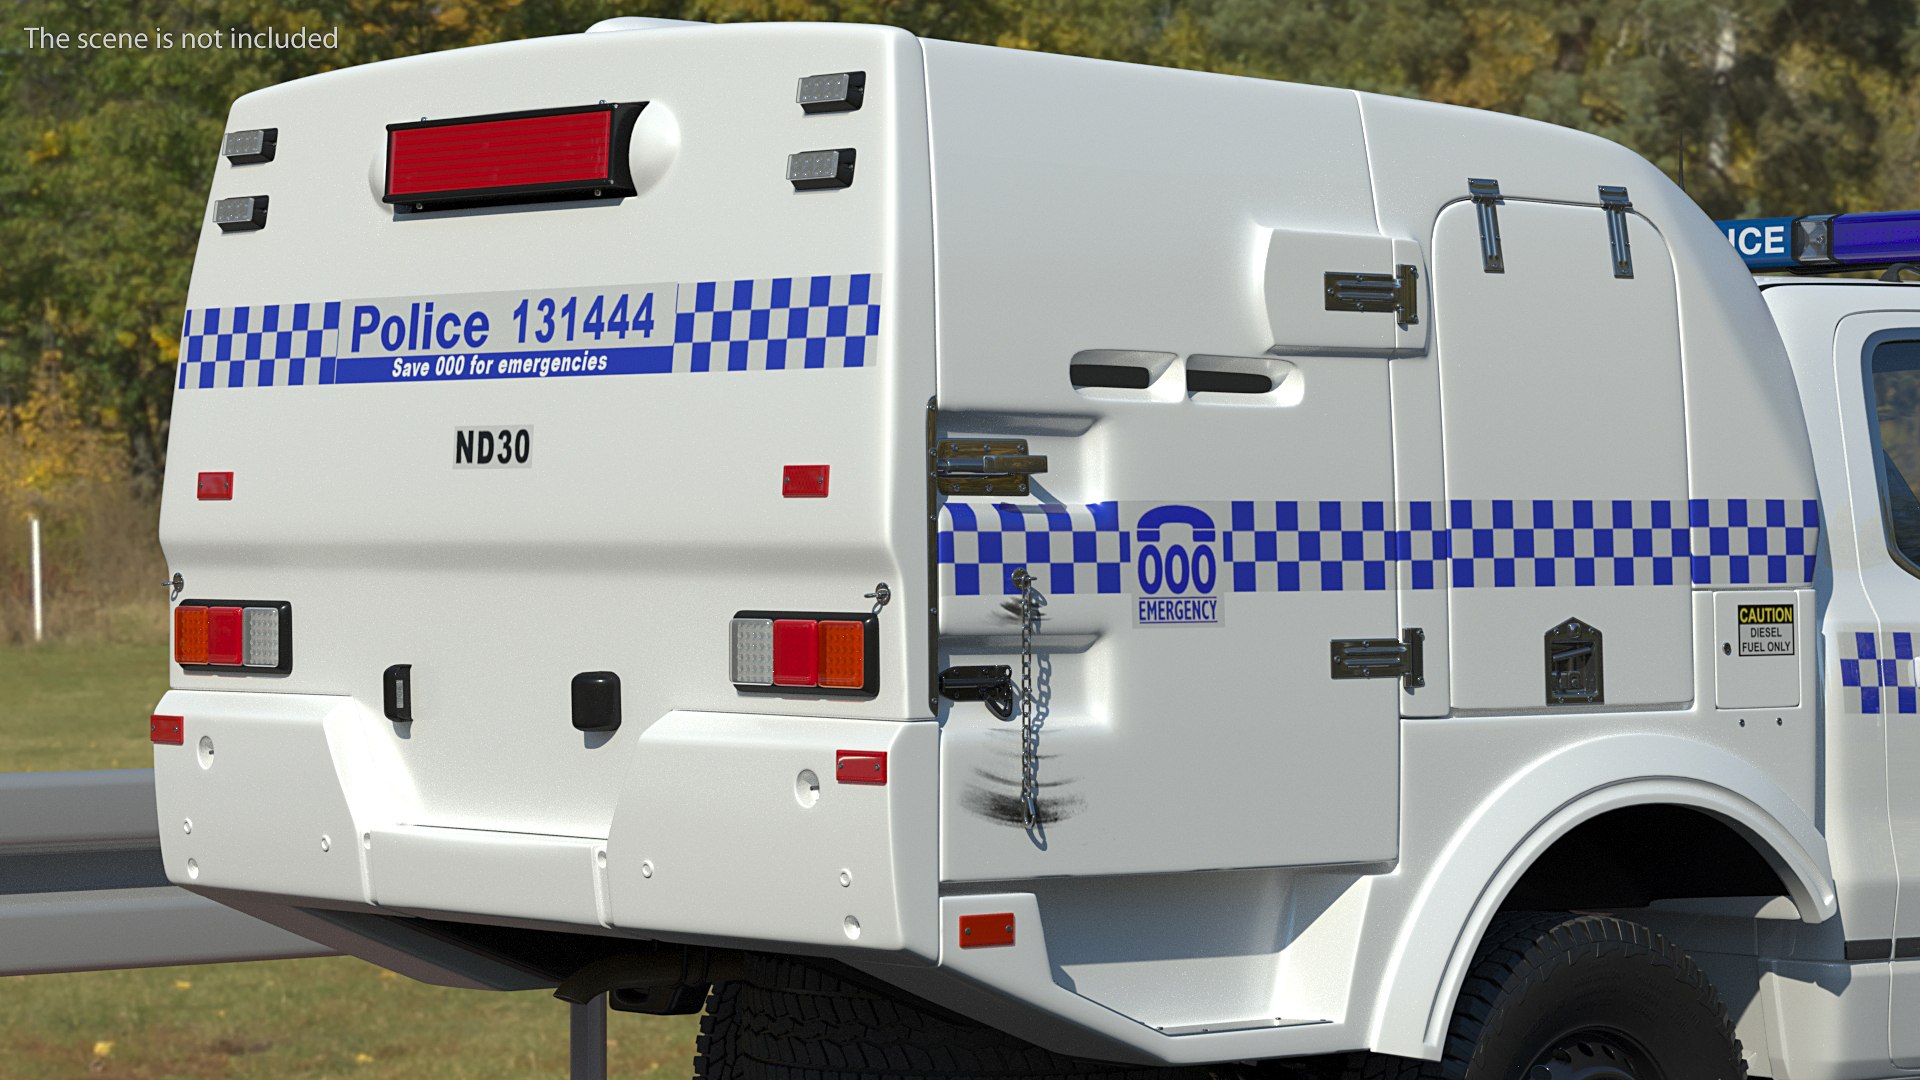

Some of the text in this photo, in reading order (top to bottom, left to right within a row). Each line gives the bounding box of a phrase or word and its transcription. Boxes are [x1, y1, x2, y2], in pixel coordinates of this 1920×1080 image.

[351, 292, 655, 353] Police 131444
[391, 350, 608, 378] Save 000 for emergencies
[455, 428, 530, 464] ND30
[1138, 544, 1216, 594] 000
[1139, 600, 1217, 620] EMERGENCY
[1739, 607, 1792, 623] CAUTION
[1750, 627, 1782, 638] DIESEL
[1742, 641, 1791, 652] FUEL ONLY
